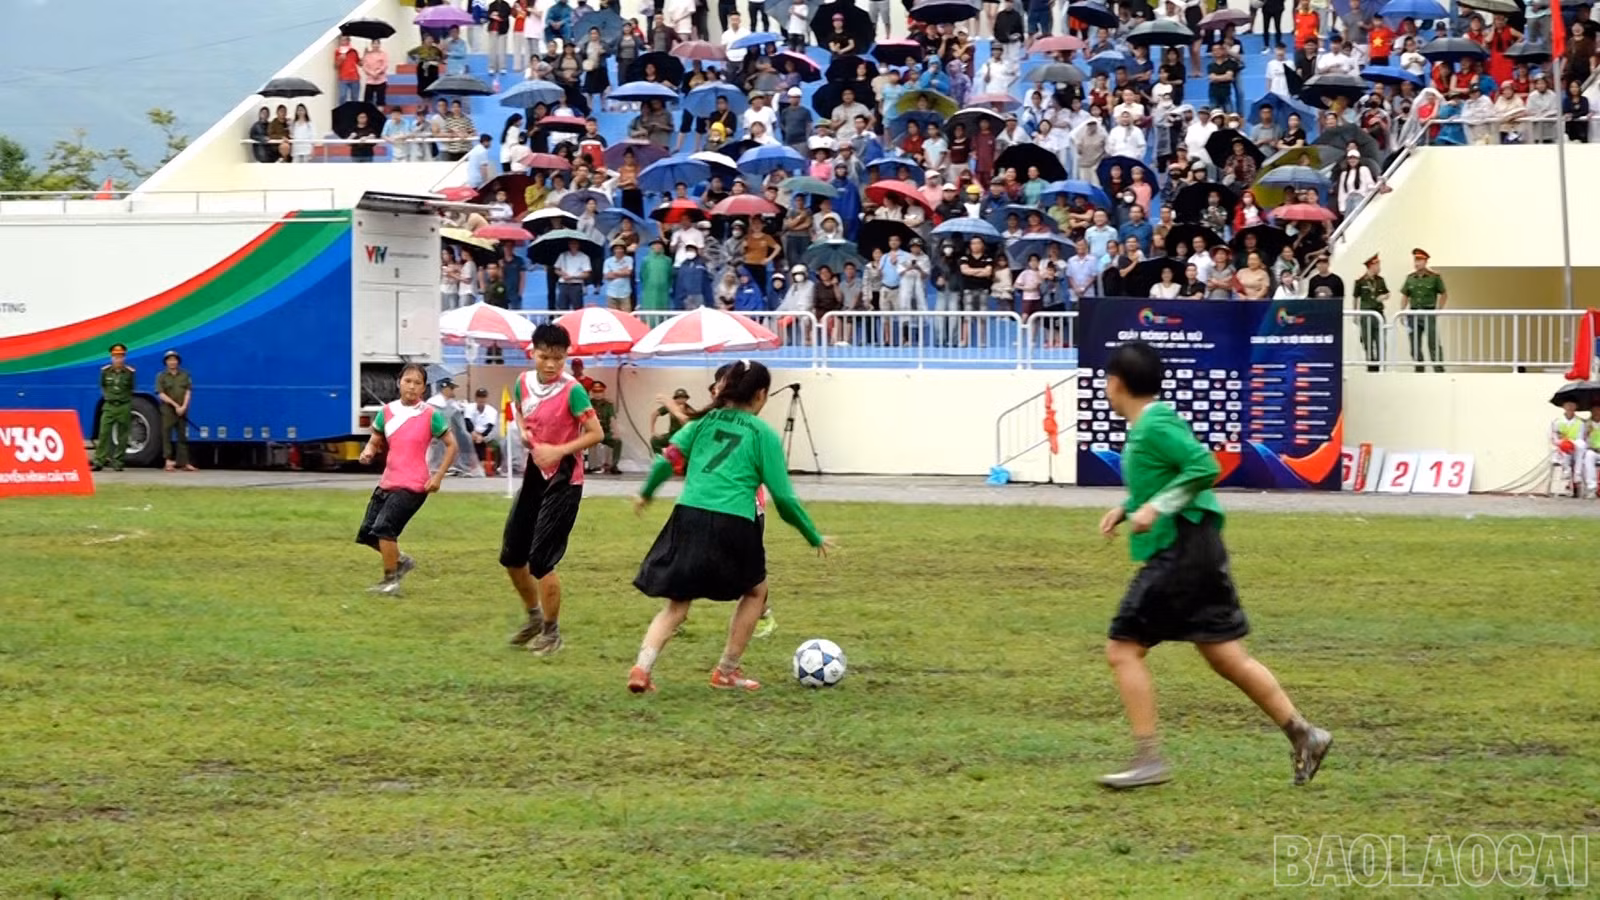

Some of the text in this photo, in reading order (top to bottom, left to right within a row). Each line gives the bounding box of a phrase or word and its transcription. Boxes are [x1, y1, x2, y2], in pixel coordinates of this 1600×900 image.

[0, 302, 27, 313] TING
[702, 429, 742, 473] 7
[1390, 461, 1409, 487] 2
[1429, 461, 1465, 487] 13
